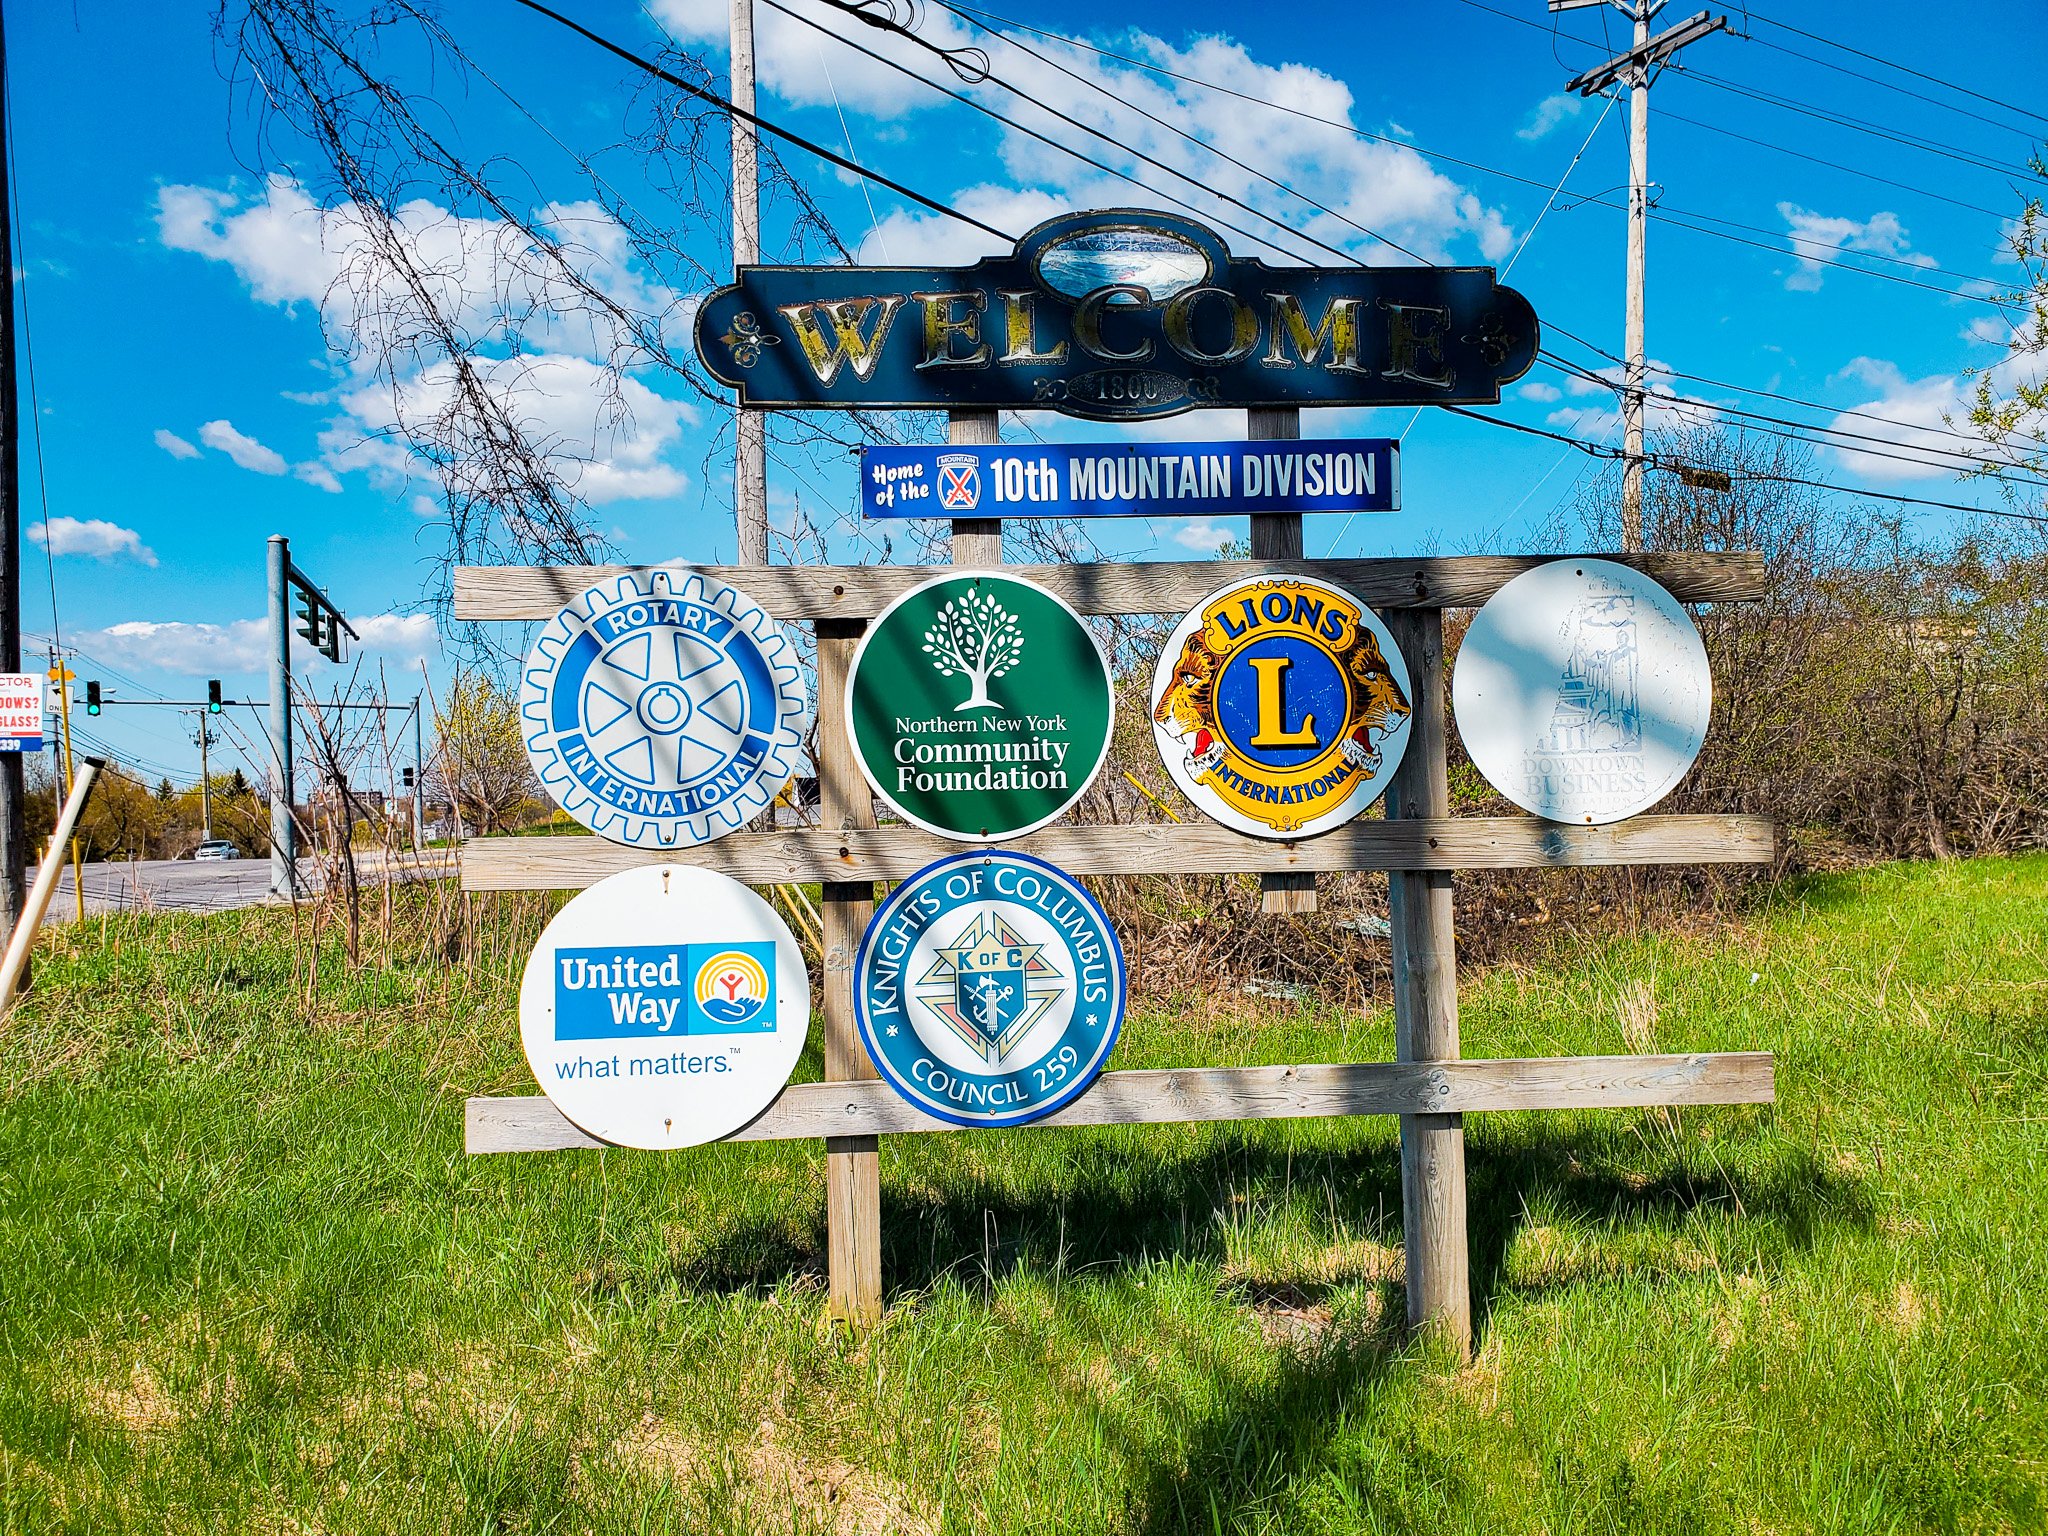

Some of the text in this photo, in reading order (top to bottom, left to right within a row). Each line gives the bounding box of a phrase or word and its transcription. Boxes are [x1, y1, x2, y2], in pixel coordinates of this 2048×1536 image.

[776, 284, 1457, 391] WELCOME
[1097, 375, 1158, 399] 1800
[872, 463, 924, 486] Home
[940, 455, 976, 464] MOUNTAIN
[990, 452, 1376, 502] 10th MOUNTAIN DIVISION
[875, 481, 930, 508] of the
[606, 602, 724, 636] ROTARY
[1214, 592, 1348, 642] LIONS
[1248, 657, 1321, 750] L
[895, 714, 1068, 734] Northern New York
[894, 736, 1071, 768] Community
[1522, 755, 1646, 775] DOWNTOWN
[565, 743, 764, 815] INTERNATIONAL
[896, 764, 1069, 793] Foundation
[1209, 757, 1361, 806] INTERNATIONAL
[1523, 771, 1647, 796] BUSINESS
[870, 867, 1108, 1017] KNIGHTS OF COLUMBUS
[560, 953, 681, 991] United
[957, 948, 1023, 971] K OF C
[607, 991, 681, 1032] Way
[555, 1052, 733, 1080] what matters.
[911, 1045, 1079, 1106] COUNCIL 259
